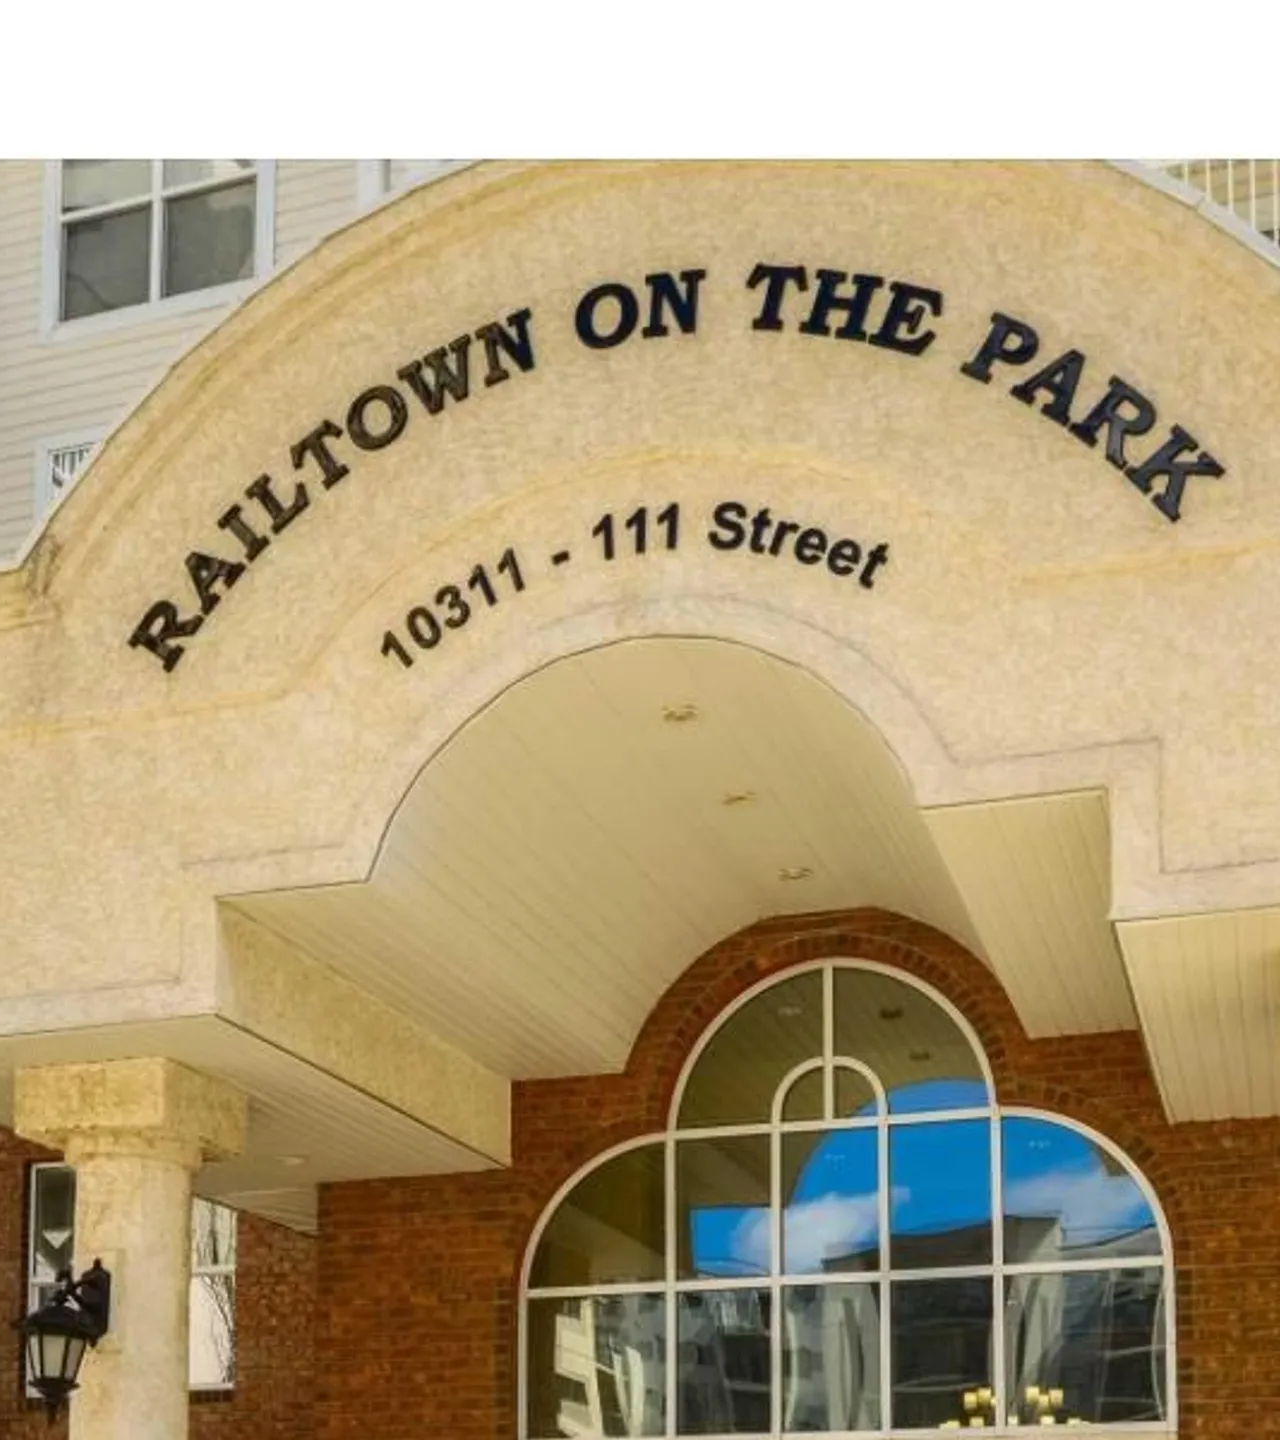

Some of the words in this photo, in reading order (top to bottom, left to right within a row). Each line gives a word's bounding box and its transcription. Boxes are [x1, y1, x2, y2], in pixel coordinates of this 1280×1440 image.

[127, 305, 537, 674] RAILTOWN
[573, 268, 708, 351] ON
[745, 261, 944, 358] THE
[959, 311, 1228, 525] PARK
[380, 548, 526, 668] 10311
[551, 550, 570, 566] -
[592, 502, 680, 561] 111
[707, 501, 890, 590] Street
